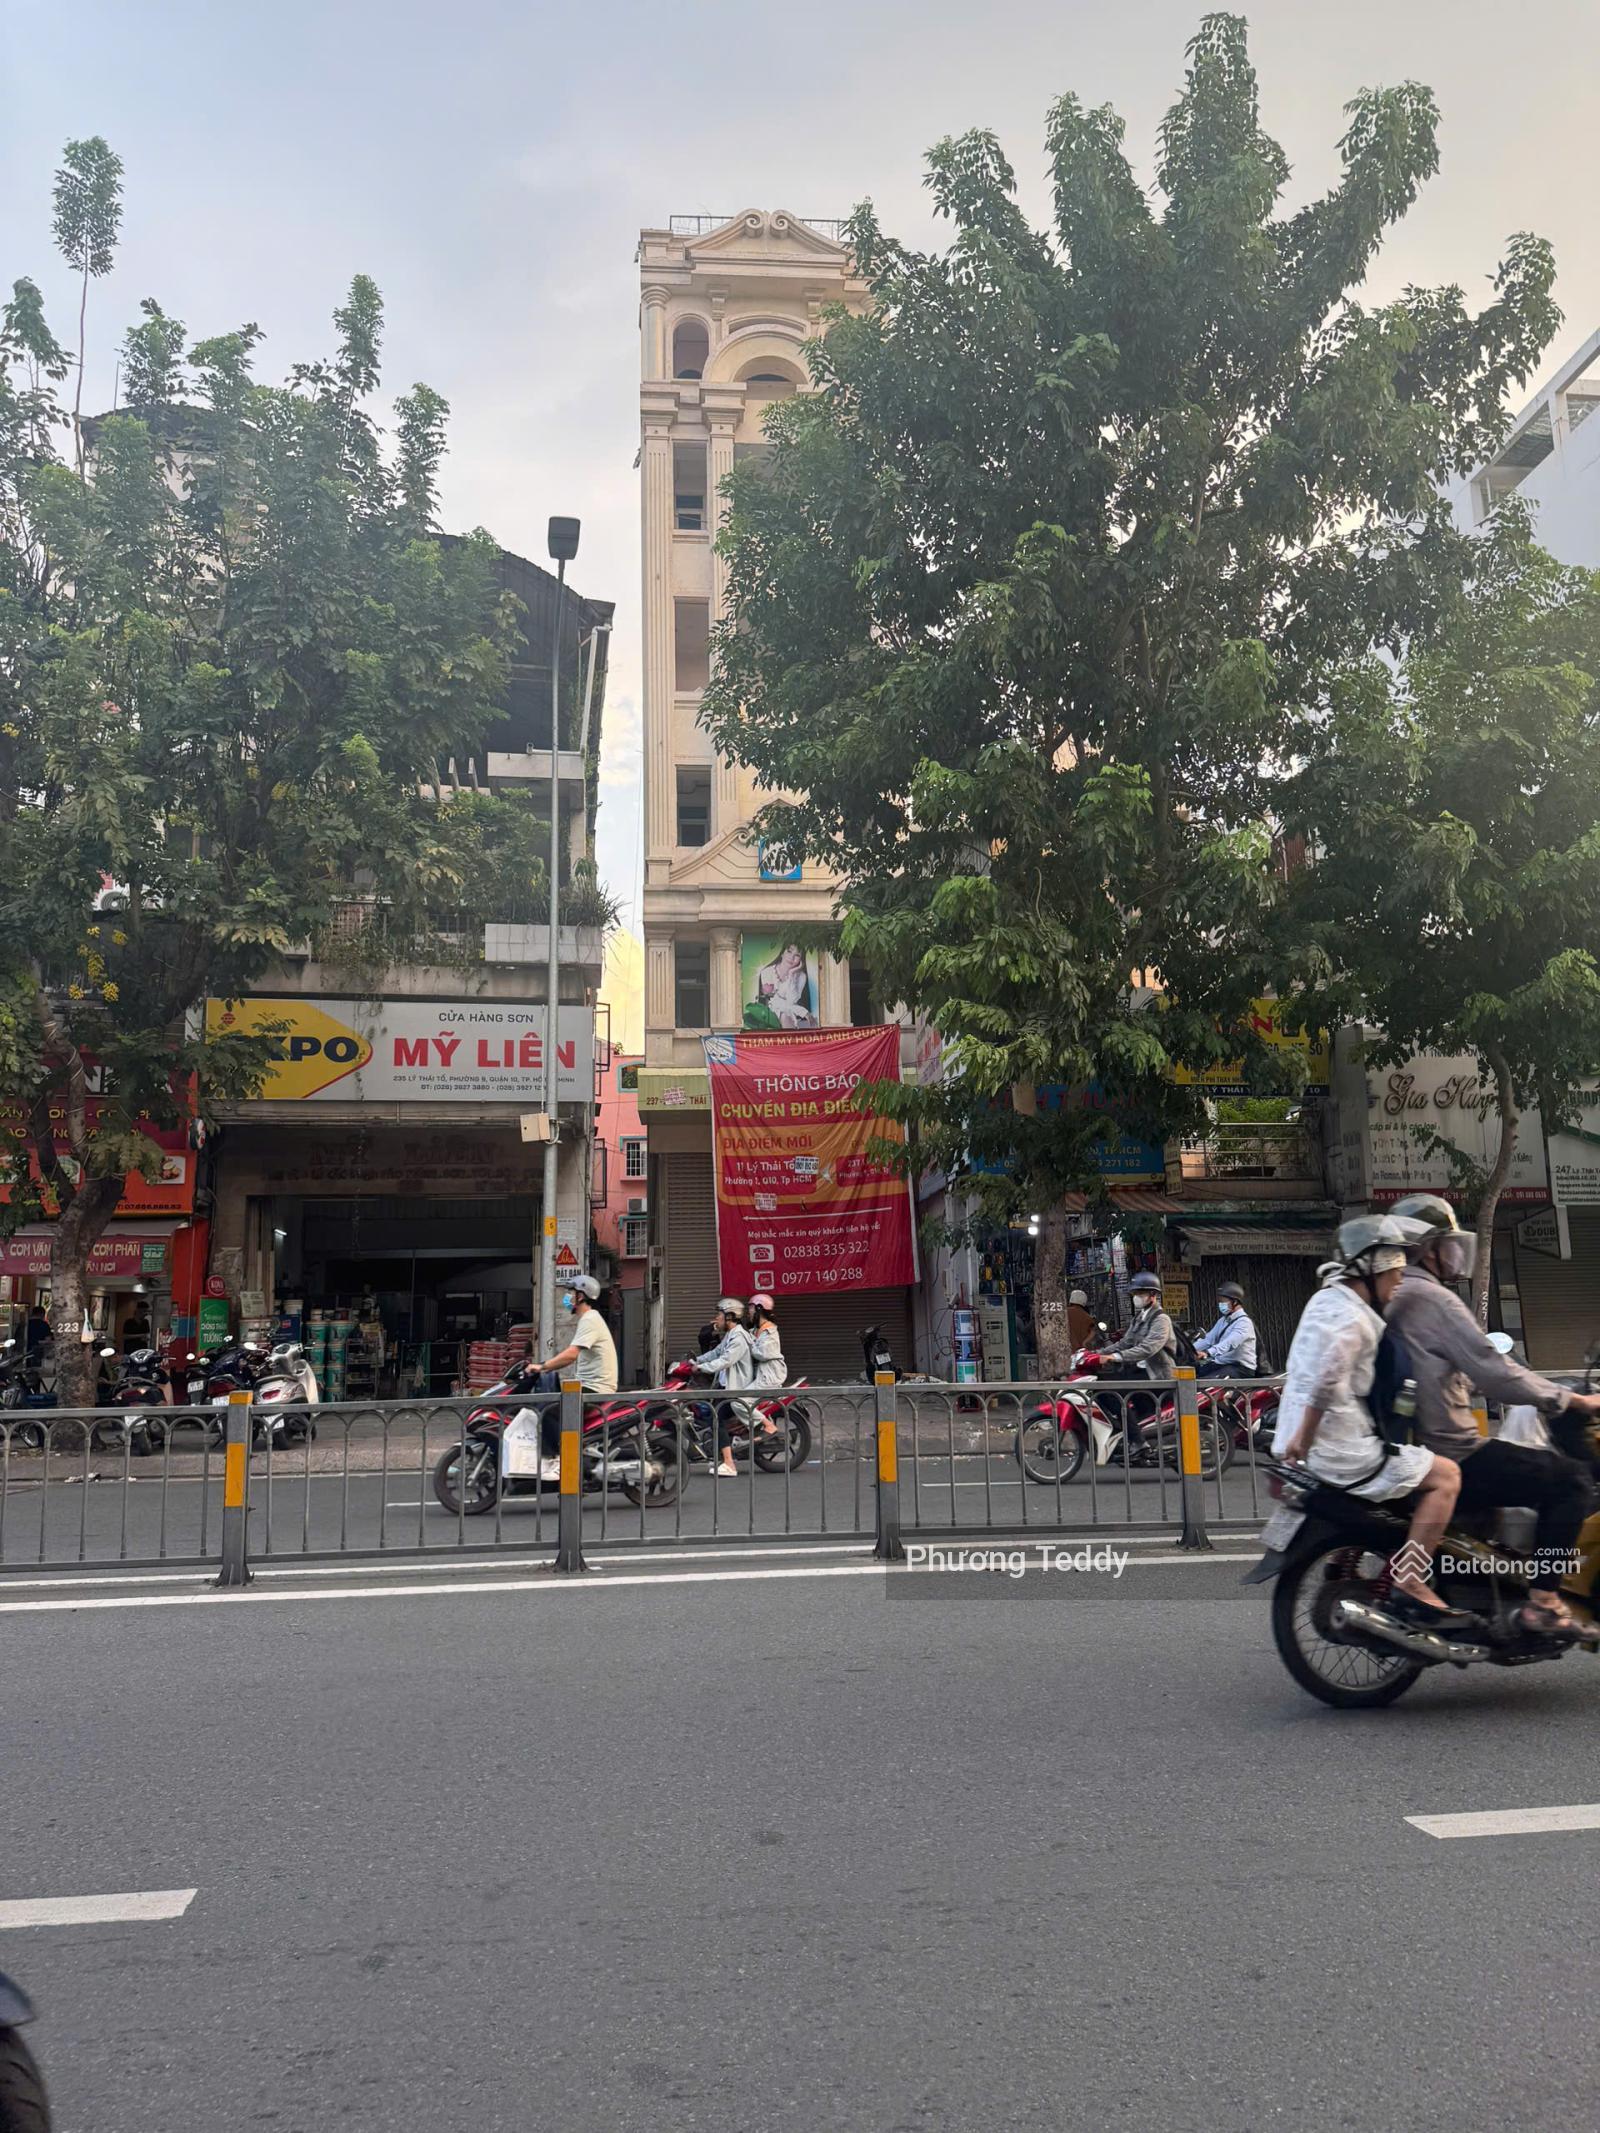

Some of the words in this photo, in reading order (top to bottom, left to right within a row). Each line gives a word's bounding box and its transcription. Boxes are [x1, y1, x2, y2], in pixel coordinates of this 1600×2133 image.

[438, 1009, 465, 1022] CỬA
[469, 1011, 504, 1023] HÀNG
[507, 1013, 534, 1023] SƠN
[393, 1030, 462, 1067] MỸ
[477, 1032, 576, 1069] LIÊN
[754, 1074, 820, 1094] THÔNG
[825, 1071, 861, 1090] BÁO
[1384, 1073, 1429, 1116] Gia
[646, 1097, 659, 1105] 237
[791, 1102, 819, 1119] ĐỊA
[746, 1161, 758, 1173] Lý
[1555, 1165, 1572, 1174] 247
[781, 1175, 790, 1186] Tp
[793, 1174, 813, 1184] HCM
[748, 1230, 761, 1239] Mọi
[796, 1228, 807, 1237] xin
[783, 1244, 821, 1258] 02838
[824, 1243, 845, 1256] 335
[848, 1240, 869, 1254] 322
[29, 1262, 51, 1273] GIAO
[781, 1271, 812, 1285] 0977
[816, 1269, 838, 1282] 140
[840, 1267, 863, 1281] 288
[1042, 1302, 1063, 1312] 225
[57, 1322, 79, 1334] 223
